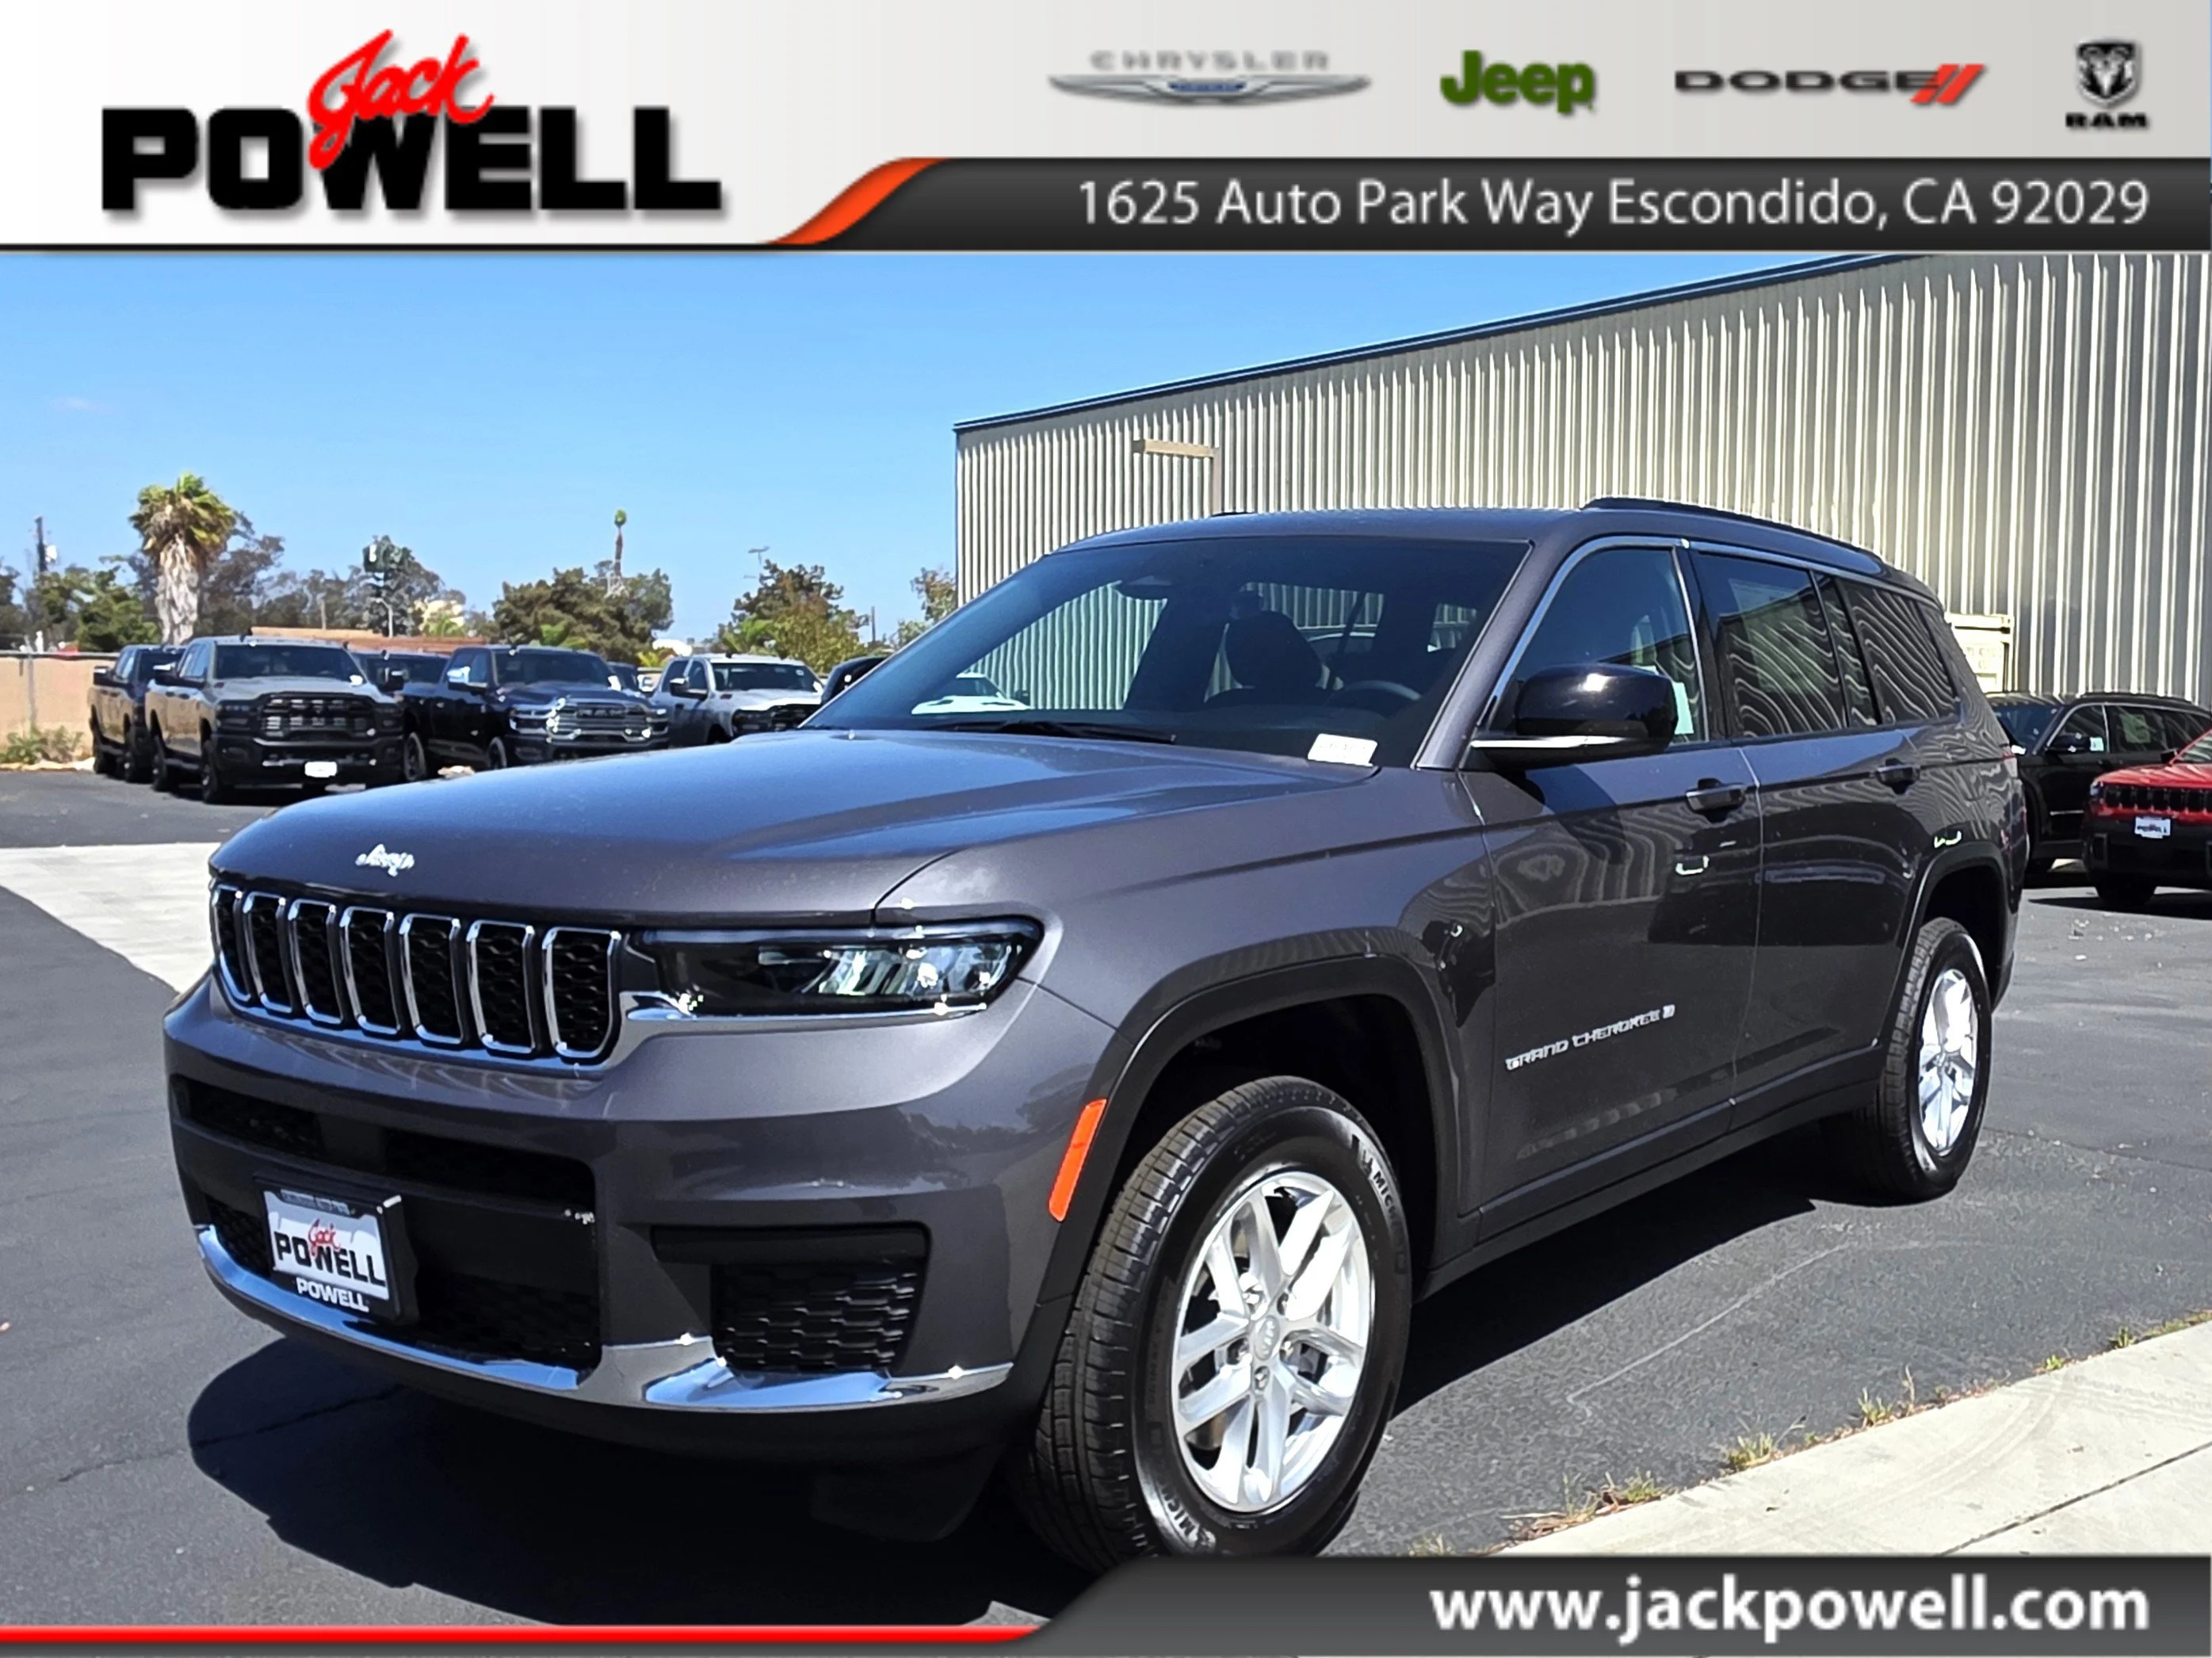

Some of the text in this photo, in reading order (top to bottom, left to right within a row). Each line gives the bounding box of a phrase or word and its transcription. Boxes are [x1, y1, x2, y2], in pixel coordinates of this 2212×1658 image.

[1506, 1040, 1569, 1070] GRAND
[1572, 1009, 1660, 1047] CHEROKEE
[274, 1232, 386, 1287] POWELL
[296, 1277, 369, 1312] POWELL
